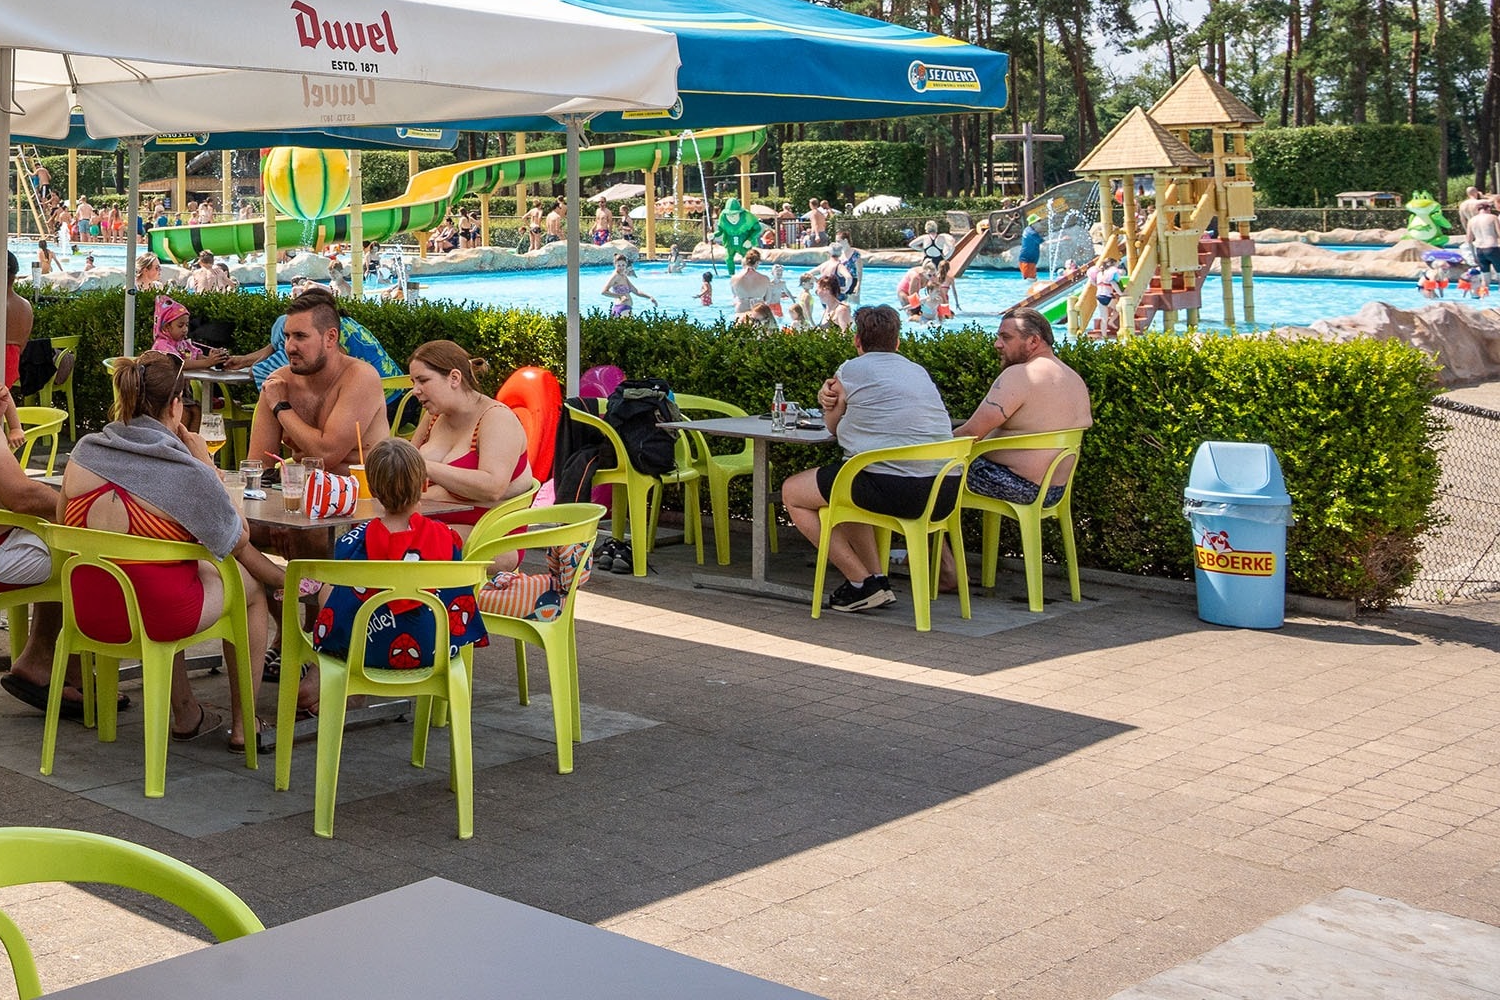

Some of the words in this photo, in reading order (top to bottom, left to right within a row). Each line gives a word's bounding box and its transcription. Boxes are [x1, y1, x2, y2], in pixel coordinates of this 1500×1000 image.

[290, 0, 399, 55] Duvel
[331, 60, 358, 72] ESTD.
[360, 62, 379, 74] 1871
[928, 68, 976, 82] SEZOENS
